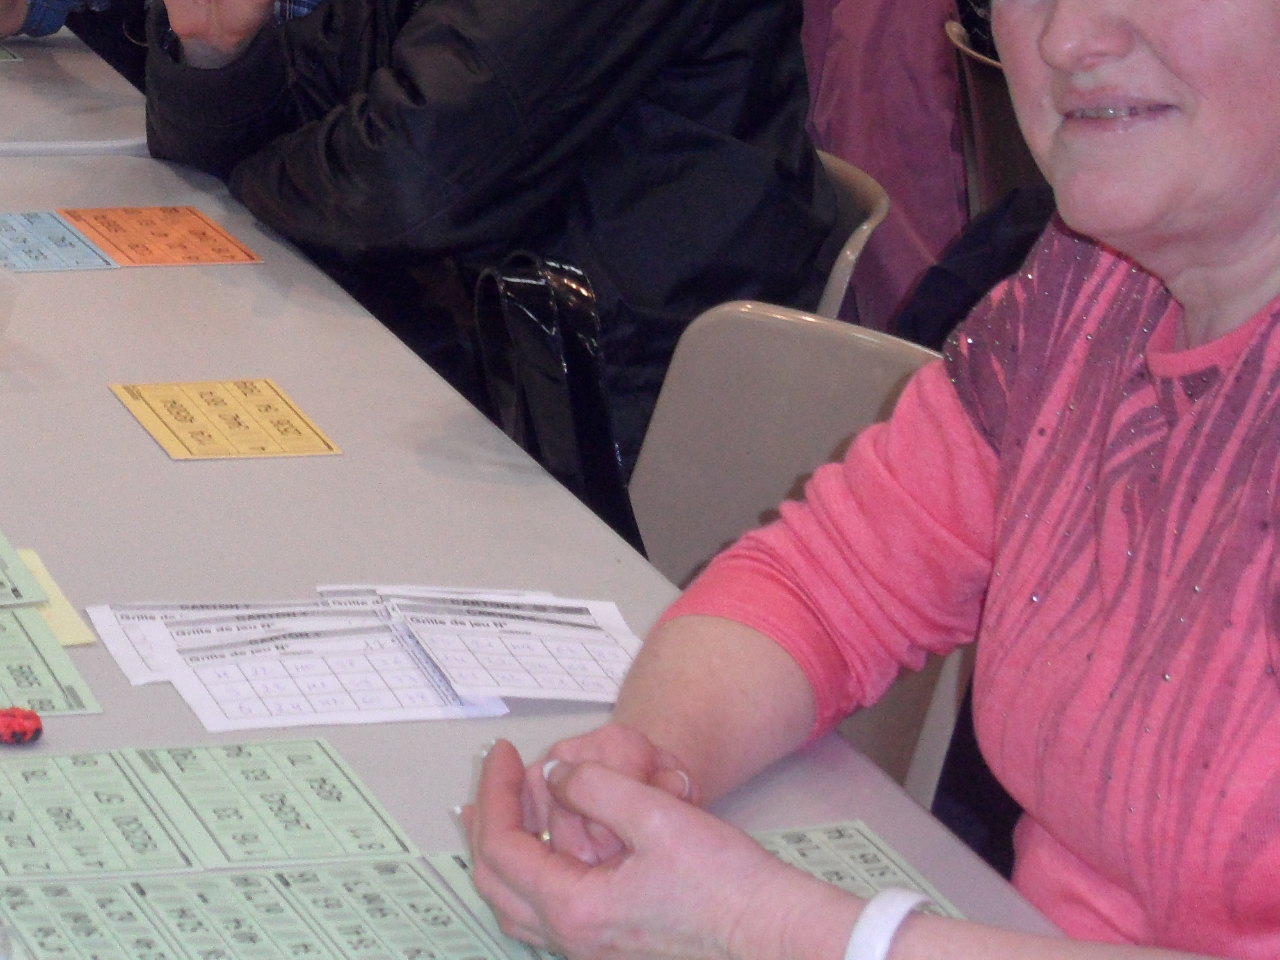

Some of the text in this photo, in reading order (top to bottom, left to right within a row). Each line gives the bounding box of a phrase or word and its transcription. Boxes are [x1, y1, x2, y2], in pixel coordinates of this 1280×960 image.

[410, 616, 446, 626] Grille
[469, 620, 490, 628] jeu
[176, 628, 211, 636] Grille
[189, 653, 226, 662] Grille
[250, 646, 271, 655] jeu
